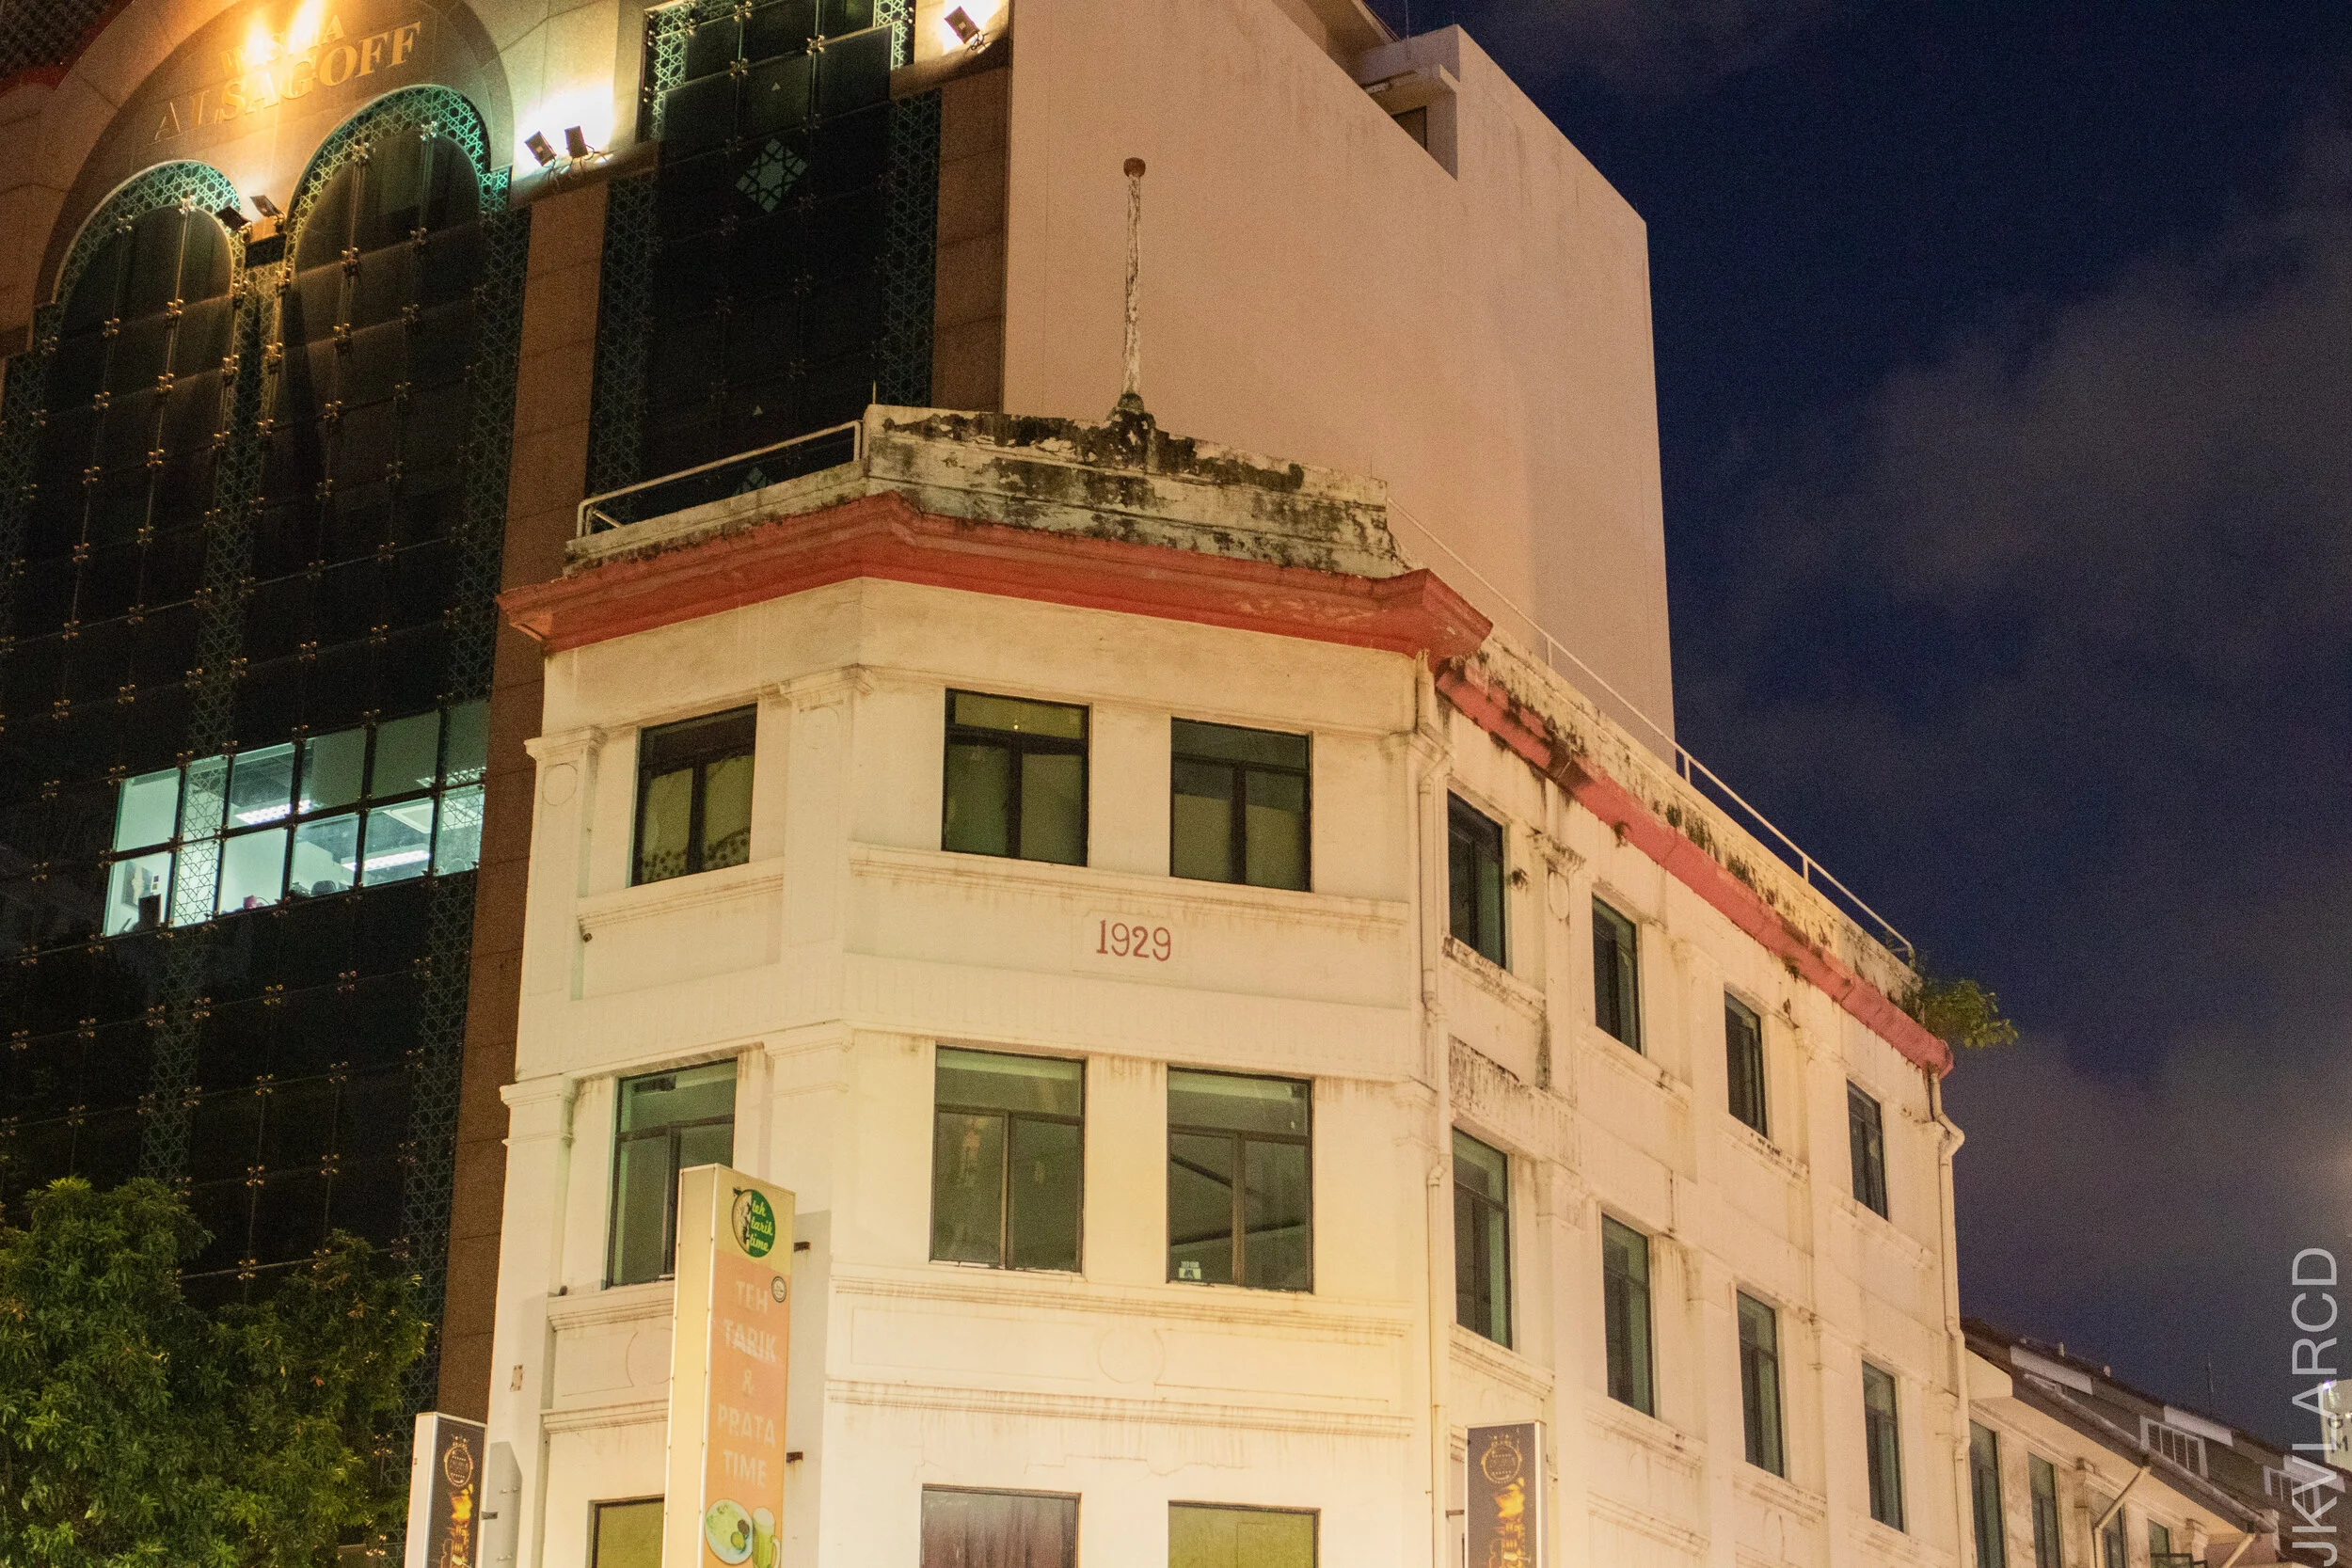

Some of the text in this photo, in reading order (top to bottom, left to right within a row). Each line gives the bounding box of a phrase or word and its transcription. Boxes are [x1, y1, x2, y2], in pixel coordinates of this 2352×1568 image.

[1096, 920, 1171, 961] 1929
[750, 1216, 773, 1236] tarik
[752, 1200, 767, 1217] teh
[749, 1233, 770, 1252] time
[736, 1279, 769, 1315] TEH
[723, 1319, 777, 1364] TARIK
[741, 1369, 754, 1396] &
[717, 1402, 776, 1449] PRATA
[723, 1449, 767, 1489] TIME
